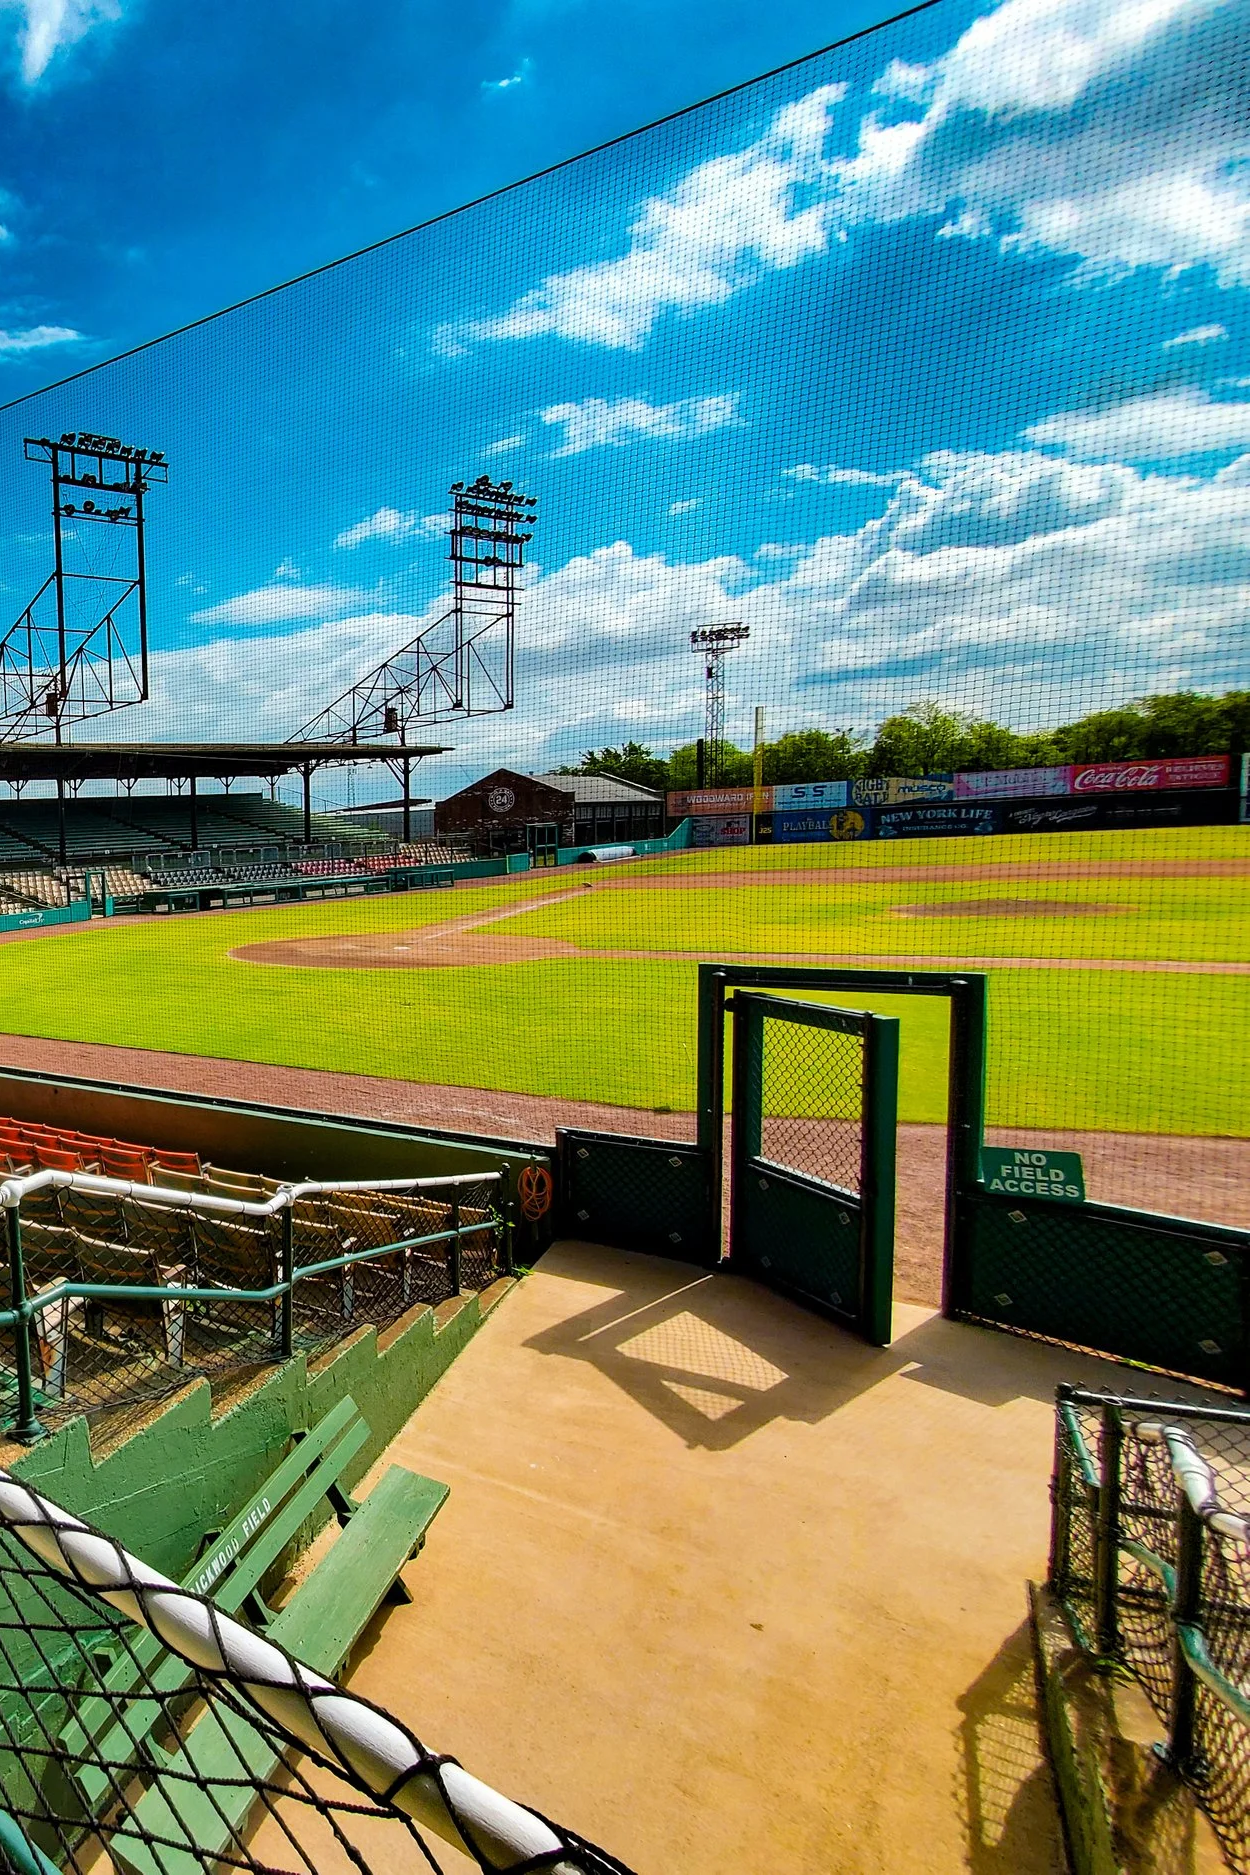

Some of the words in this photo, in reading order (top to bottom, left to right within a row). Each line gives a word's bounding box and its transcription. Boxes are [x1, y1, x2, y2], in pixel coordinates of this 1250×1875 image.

[495, 795, 508, 805] 24
[686, 792, 743, 804] WOODWARD
[881, 811, 913, 824] NEW
[916, 808, 958, 820] YORK
[961, 808, 993, 820] LIFE
[1014, 1152, 1047, 1166] NO
[1000, 1165, 1065, 1182] FIELD
[989, 1178, 1080, 1198] ACCESS
[242, 1497, 271, 1538] FIELD
